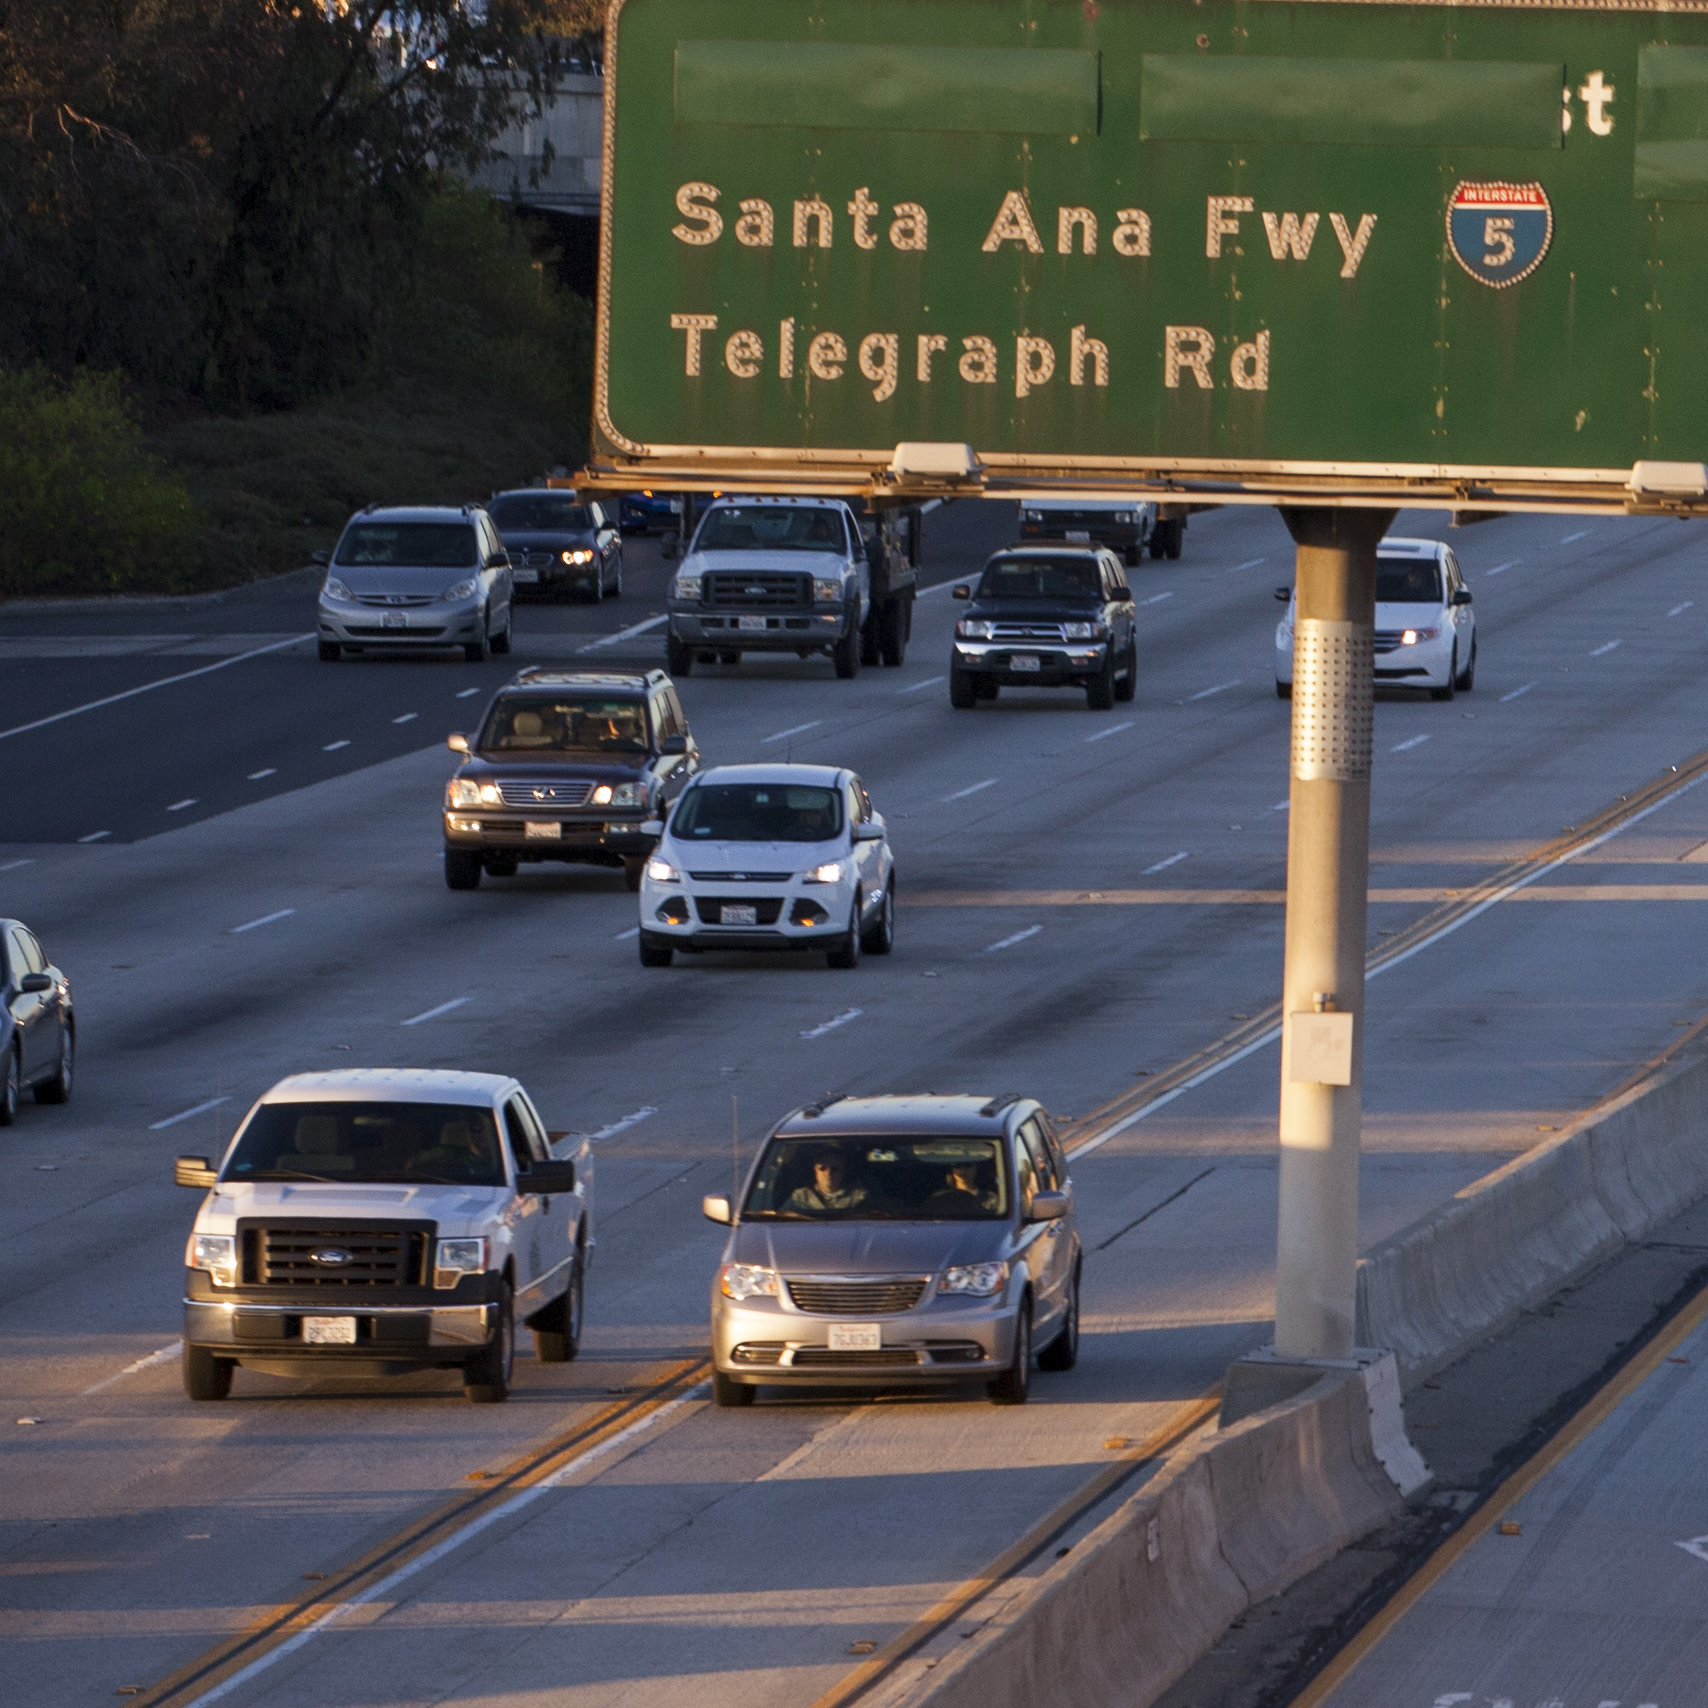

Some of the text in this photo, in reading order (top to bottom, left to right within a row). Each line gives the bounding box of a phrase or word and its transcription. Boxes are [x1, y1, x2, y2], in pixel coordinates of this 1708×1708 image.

[1464, 189, 1538, 202] INTERSTATE
[671, 182, 1379, 279] Santa Ana Fwy
[1483, 217, 1515, 266] 5
[671, 314, 1271, 402] Telegraph Rd
